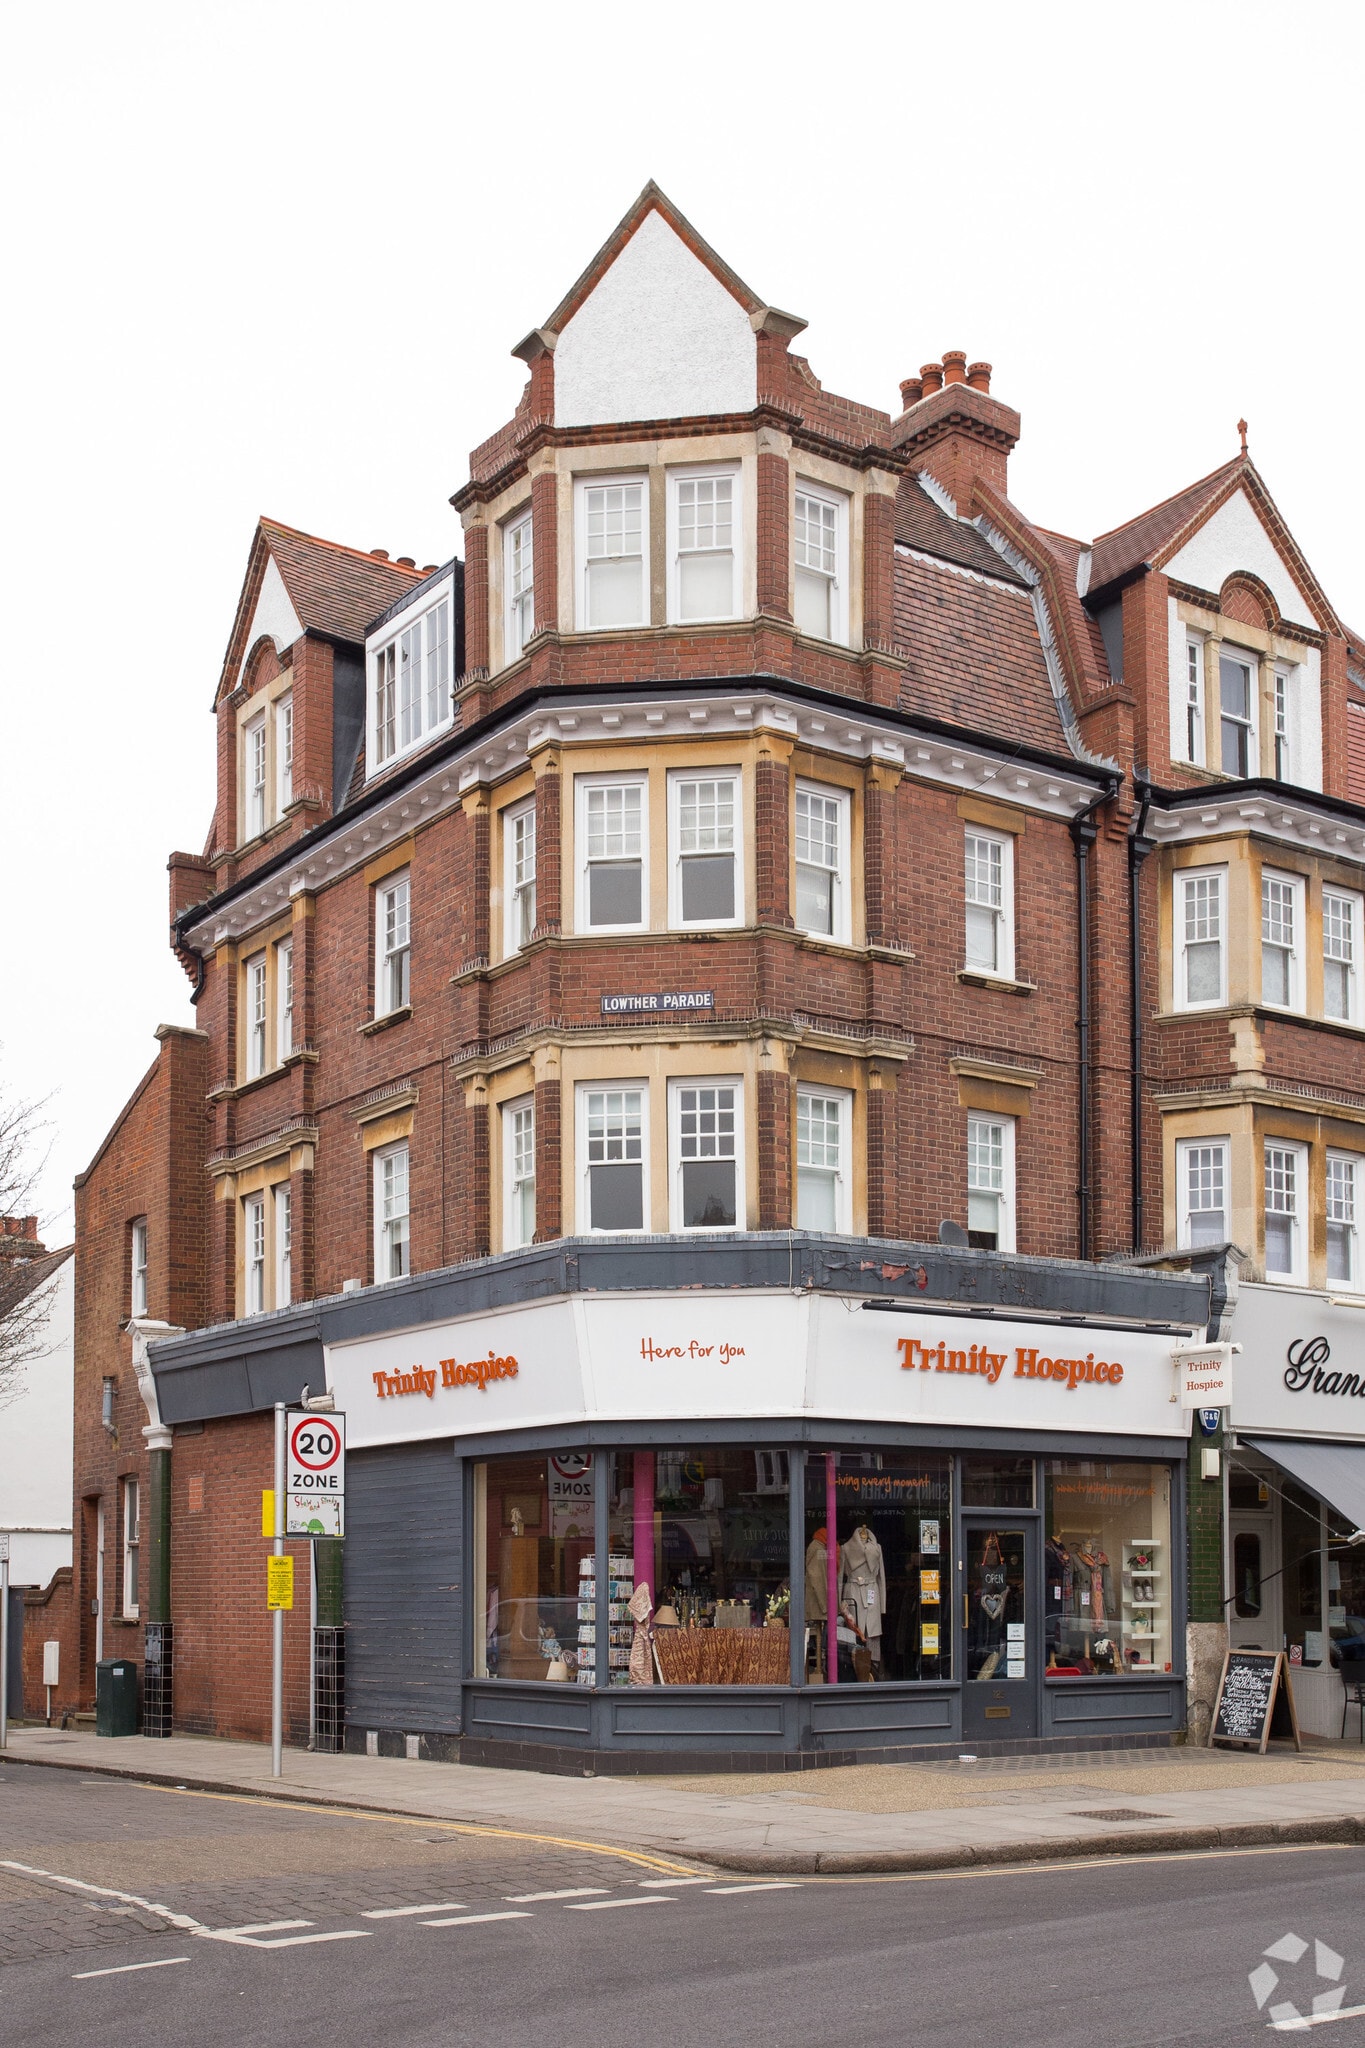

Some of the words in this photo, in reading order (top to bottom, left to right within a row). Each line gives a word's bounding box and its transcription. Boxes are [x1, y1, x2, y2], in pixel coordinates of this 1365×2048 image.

[604, 997, 658, 1011] LOWTHER
[663, 993, 711, 1008] PARADE
[640, 1337, 686, 1362] Here
[688, 1340, 714, 1359] for
[719, 1343, 745, 1365] you
[898, 1338, 1008, 1383] Trinity
[1014, 1347, 1124, 1389] Hospice
[1188, 1360, 1222, 1372] Trinity
[372, 1364, 437, 1398] Trinity
[439, 1350, 519, 1390] Hospice
[1186, 1379, 1224, 1391] Hospice
[299, 1433, 333, 1455] 20
[293, 1474, 338, 1488] ZONE
[828, 1472, 859, 1491] Living
[861, 1475, 891, 1492] every
[893, 1473, 929, 1487] moment
[985, 1573, 1004, 1584] OPEN
